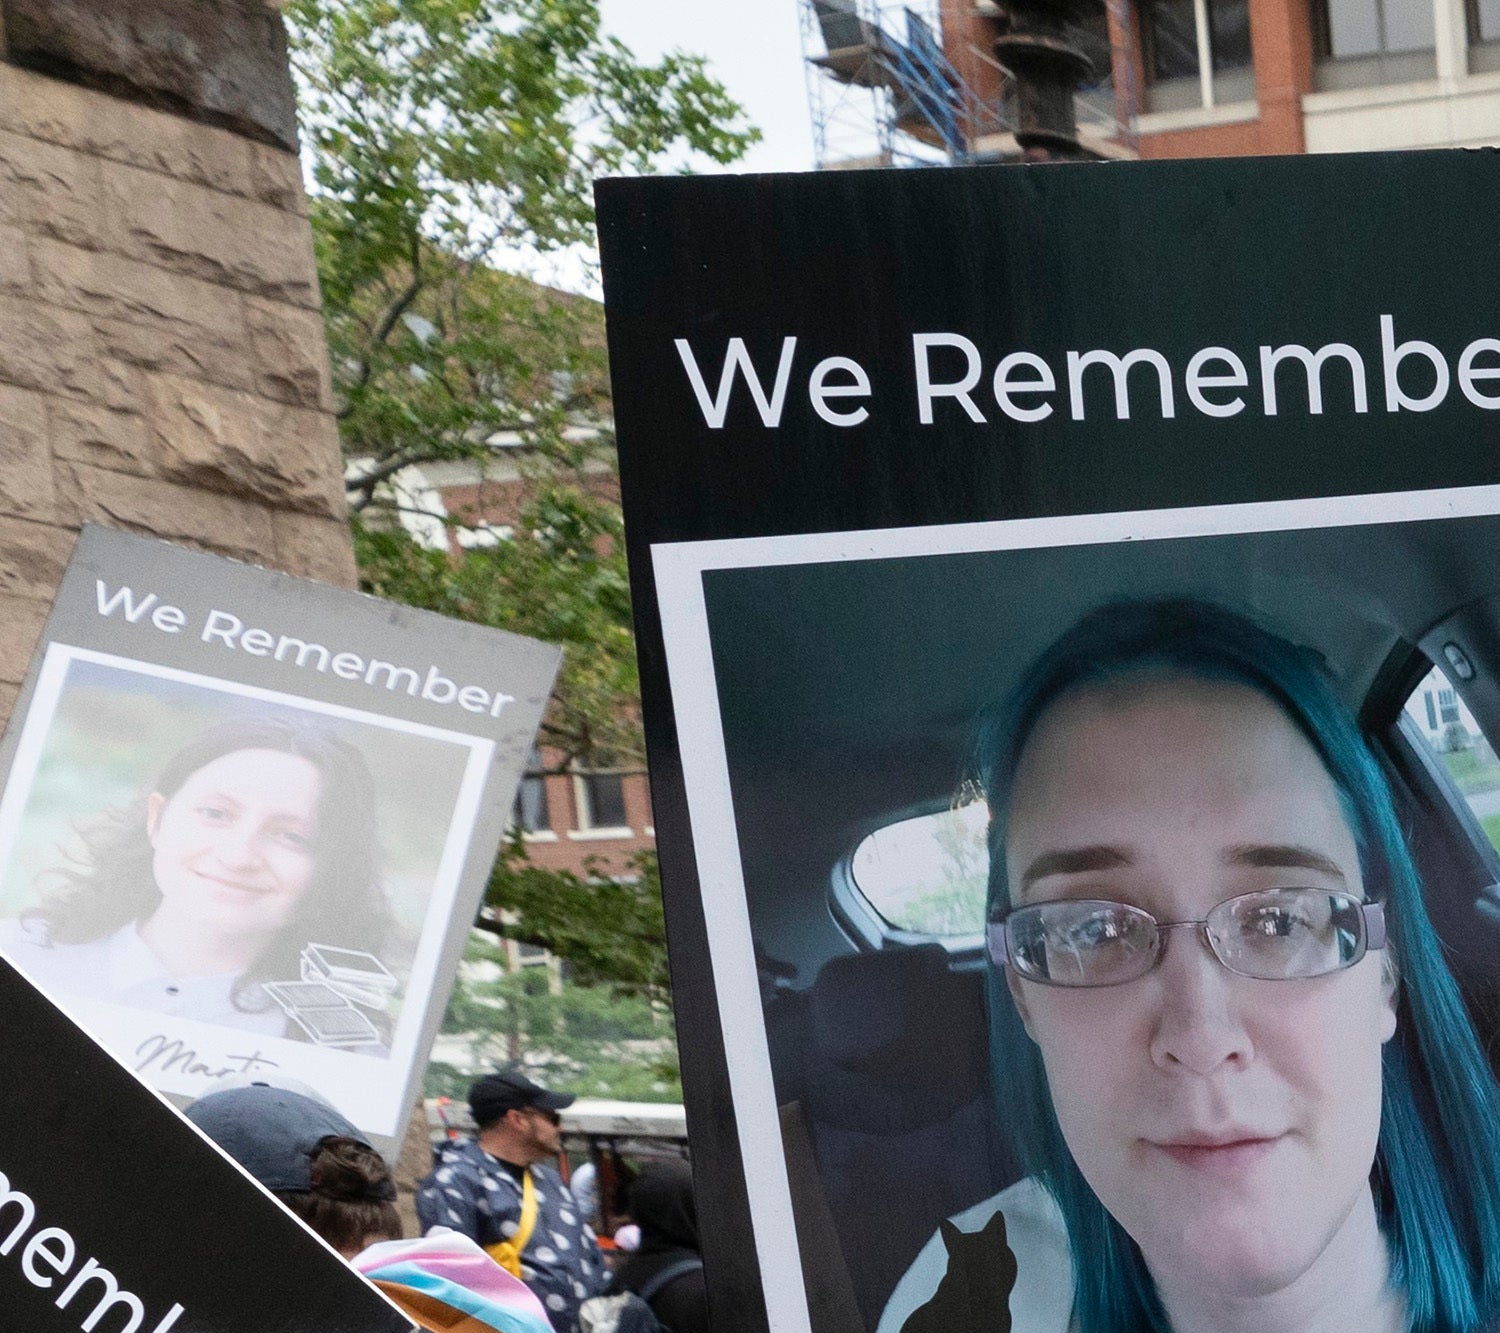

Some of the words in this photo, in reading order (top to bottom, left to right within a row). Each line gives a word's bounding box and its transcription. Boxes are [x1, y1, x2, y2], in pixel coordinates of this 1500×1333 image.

[675, 335, 871, 430] We
[93, 578, 187, 638] We
[200, 607, 517, 721] Remember
